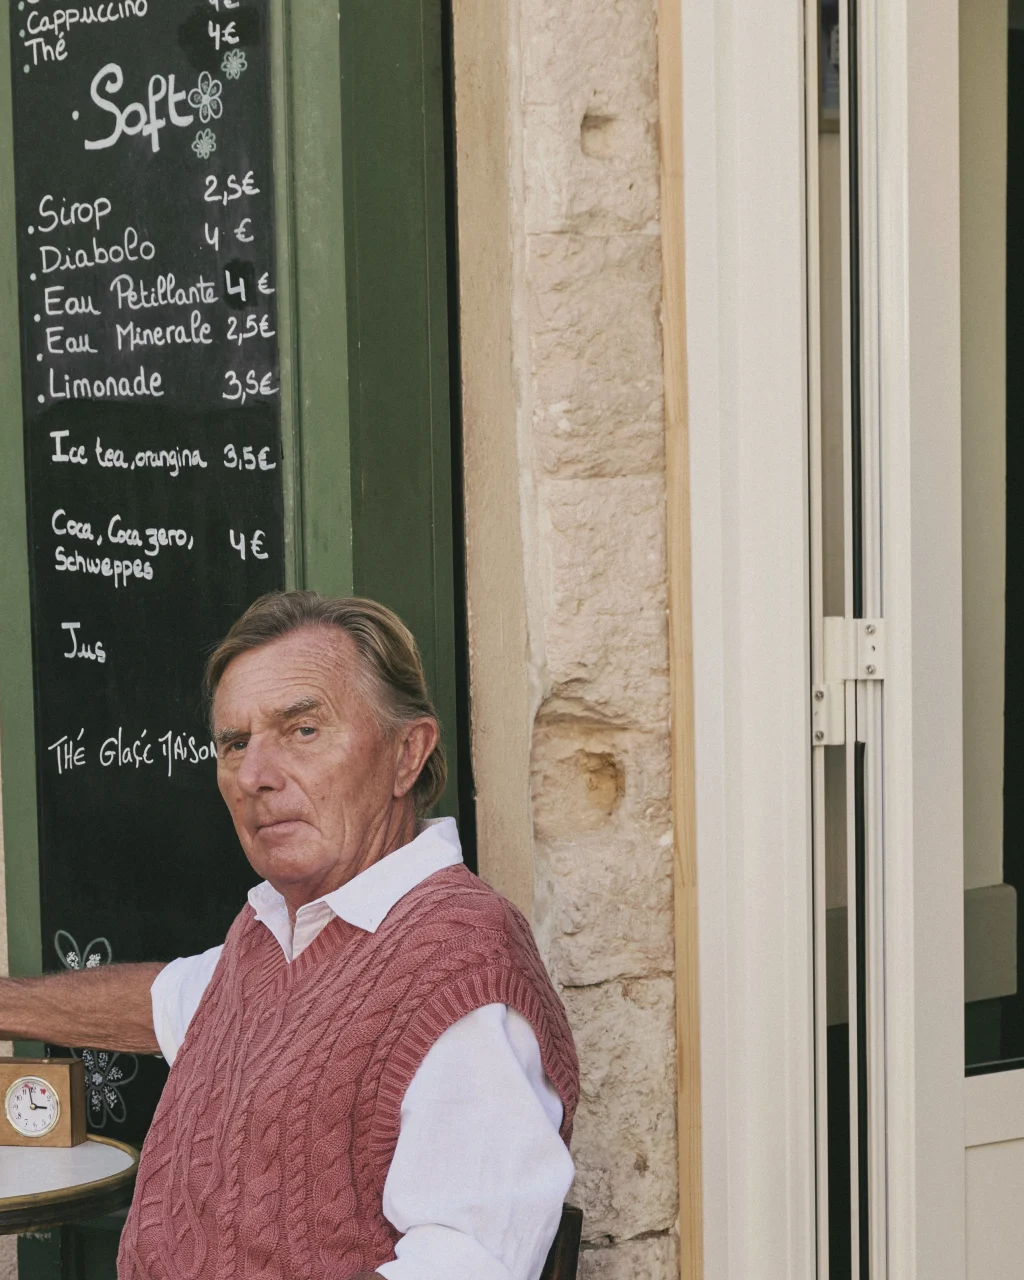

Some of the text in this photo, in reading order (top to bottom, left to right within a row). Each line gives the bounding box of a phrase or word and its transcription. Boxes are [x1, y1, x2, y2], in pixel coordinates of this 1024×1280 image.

[26, 0, 148, 36] Cappuccino
[23, 31, 68, 66] Thé
[83, 62, 194, 153] Soft
[37, 170, 261, 233] Sirop 2,5€
[39, 226, 156, 274] Diabolo
[44, 285, 102, 316] Eau
[109, 272, 219, 310] Petillante
[45, 309, 276, 354] Eau Minerale 2,5€
[49, 365, 165, 399] Limonade
[49, 429, 89, 465] Ice
[223, 443, 277, 471] 3,5€
[51, 508, 103, 546] Coca,
[54, 545, 154, 589] Schweppes
[61, 621, 107, 664] Jus
